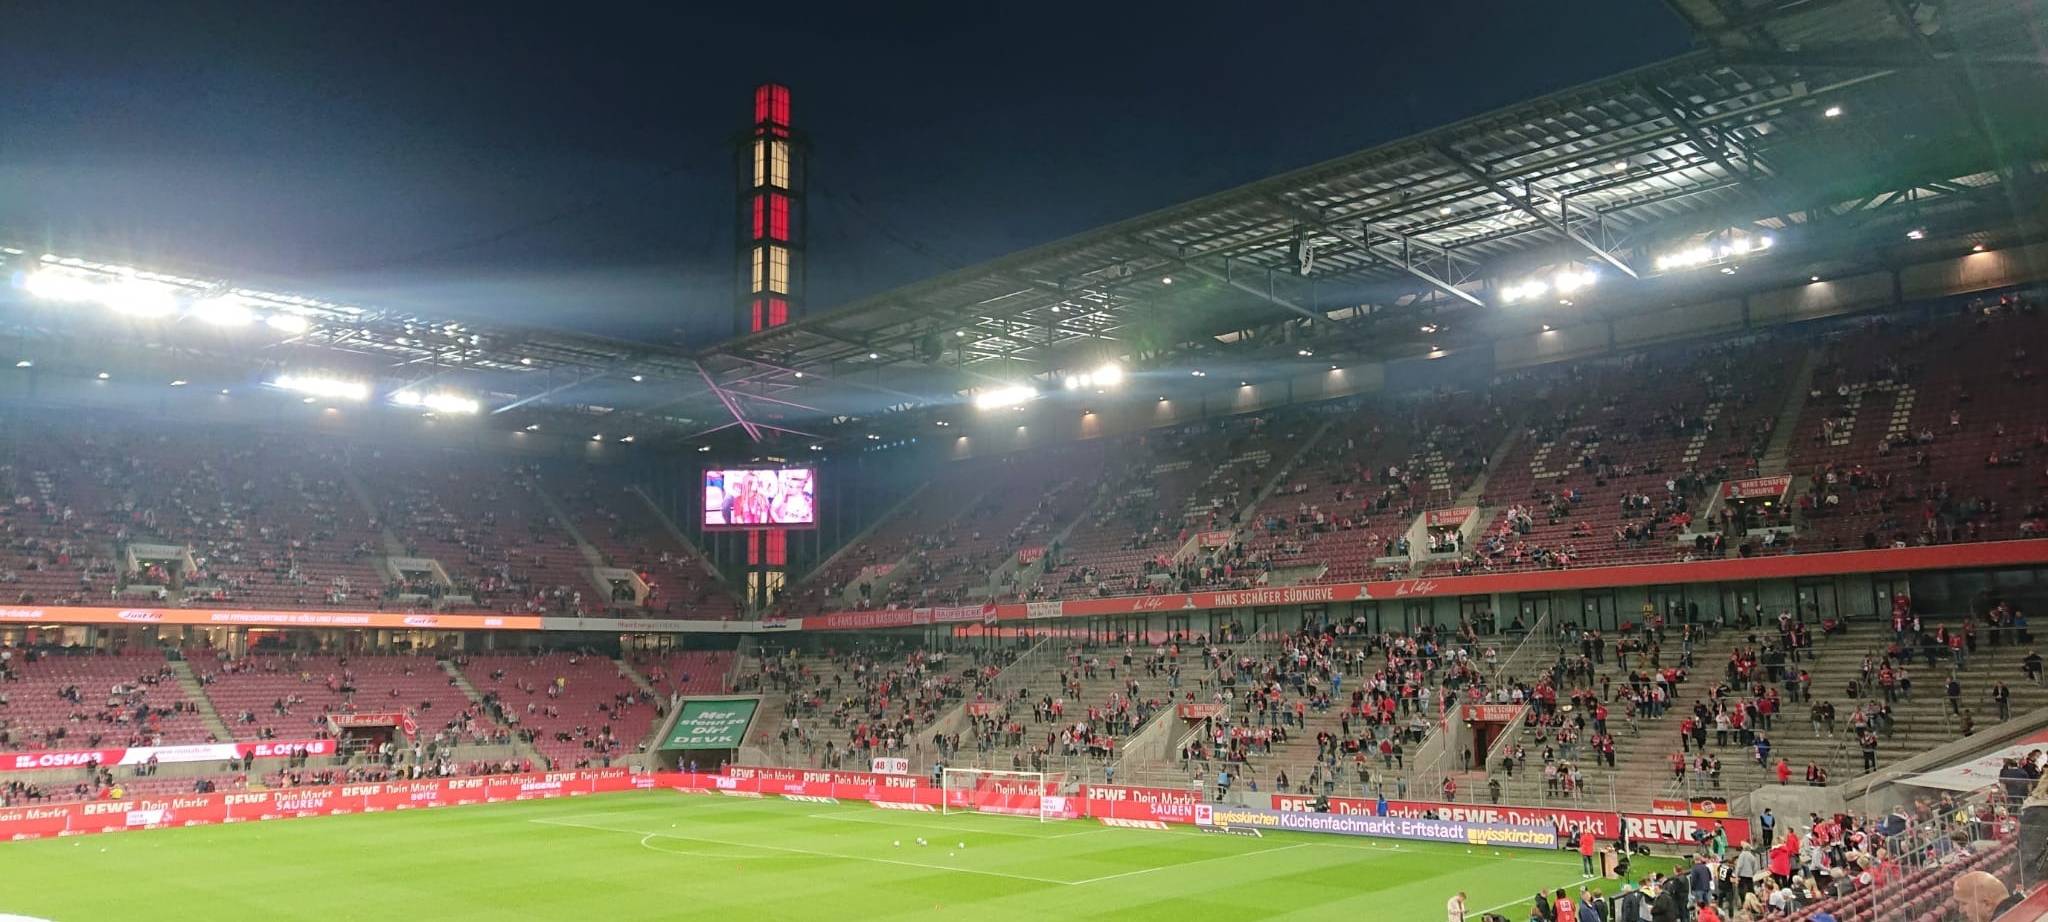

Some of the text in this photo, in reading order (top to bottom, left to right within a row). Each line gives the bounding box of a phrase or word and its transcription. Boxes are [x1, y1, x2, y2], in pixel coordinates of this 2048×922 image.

[1215, 586, 1333, 607] HANS SCHÄFER SÜDKURVE
[698, 711, 735, 719] Mer
[691, 726, 730, 734] Dir!
[874, 761, 907, 771] 48 09
[730, 768, 916, 789] REWE Dein Markt REWE Dein Markt REWE
[0, 770, 624, 822] ein Markt REWE Dein Markt REWE Dein Markt REWE Dein Markt REWE Dein Markt REWE Dein Markt
[994, 783, 1015, 796] Dein
[1133, 790, 1158, 804] Dein
[1162, 792, 1196, 805] Markt
[276, 799, 323, 811] SAUREN
[1151, 803, 1192, 816] SAUREN
[1220, 811, 1279, 826] wisskirchen
[1478, 828, 1555, 845] wisskirchen
[1340, 802, 1371, 816] Dein
[1438, 807, 1500, 824] REWE
[1507, 811, 1547, 827] Dein
[1552, 814, 1605, 836] Markt
[1628, 817, 1698, 841] REWE
